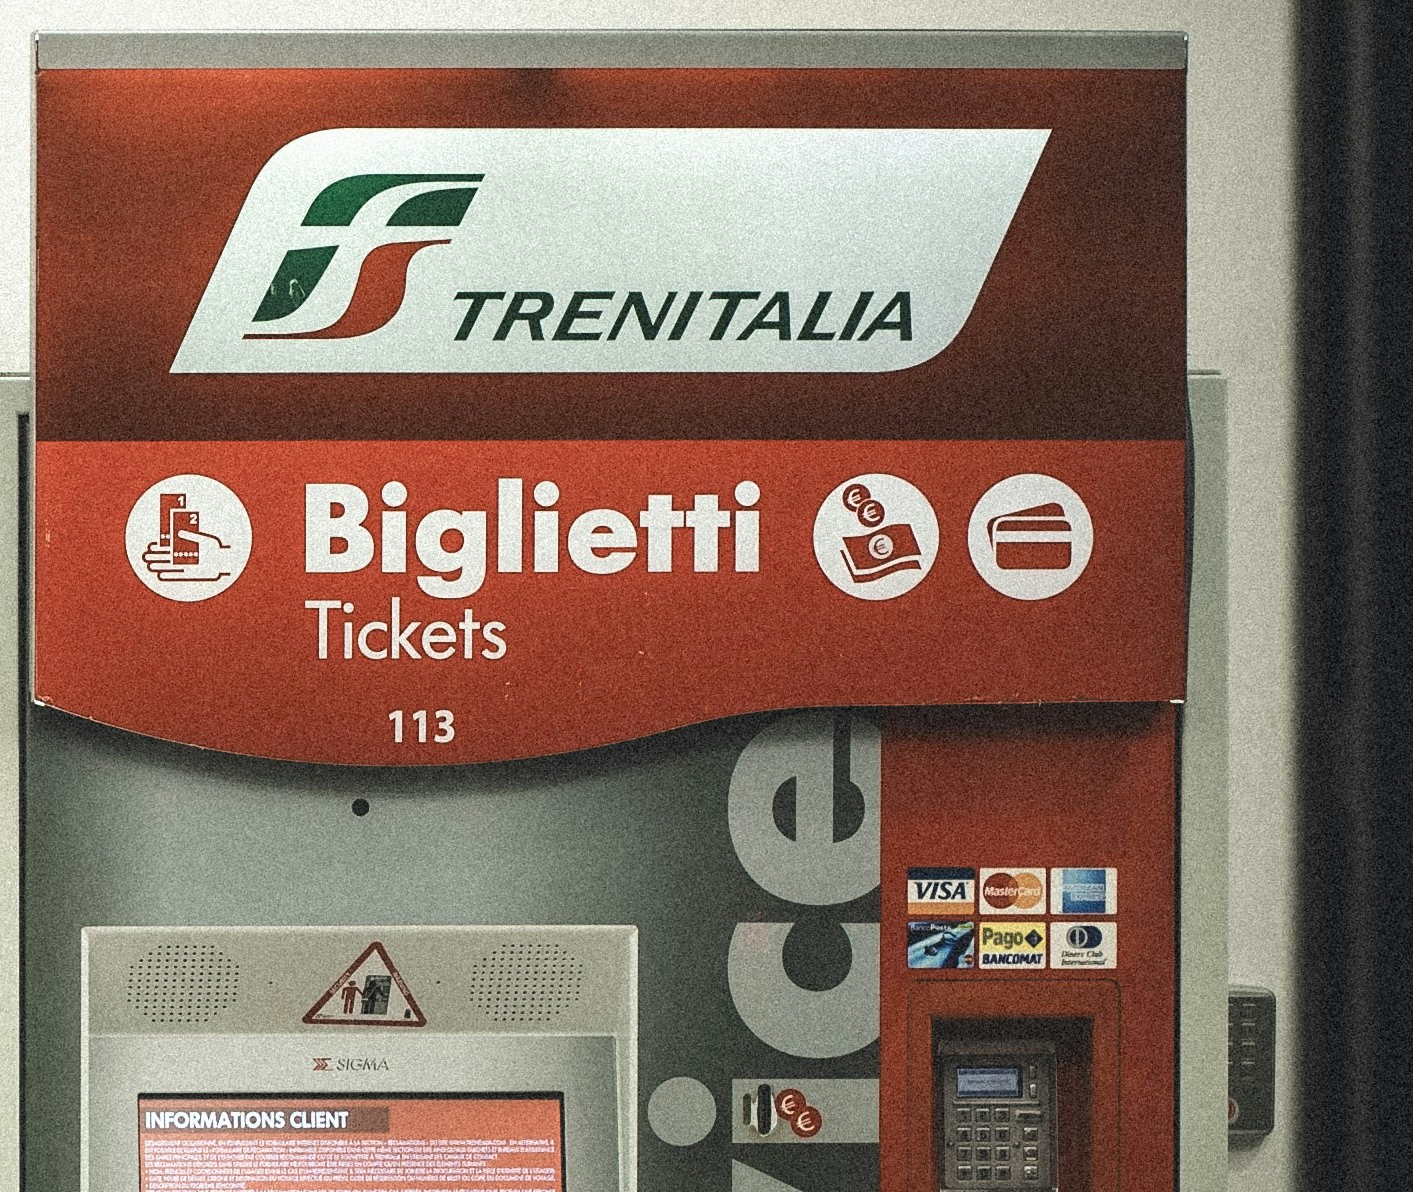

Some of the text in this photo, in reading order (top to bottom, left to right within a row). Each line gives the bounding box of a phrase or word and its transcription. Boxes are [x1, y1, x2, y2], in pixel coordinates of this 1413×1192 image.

[453, 290, 914, 342] TRENITALIA
[304, 478, 761, 599] Biglietti
[305, 598, 508, 663] Tickets
[387, 709, 456, 744] 113
[914, 881, 967, 899] VISA
[984, 886, 1042, 897] MasterCard
[982, 927, 1024, 949] Pago
[982, 953, 1044, 965] BANCOMAT
[336, 1058, 390, 1072] SIGMA
[144, 1110, 349, 1130] INFORMATIONS CLIENT
